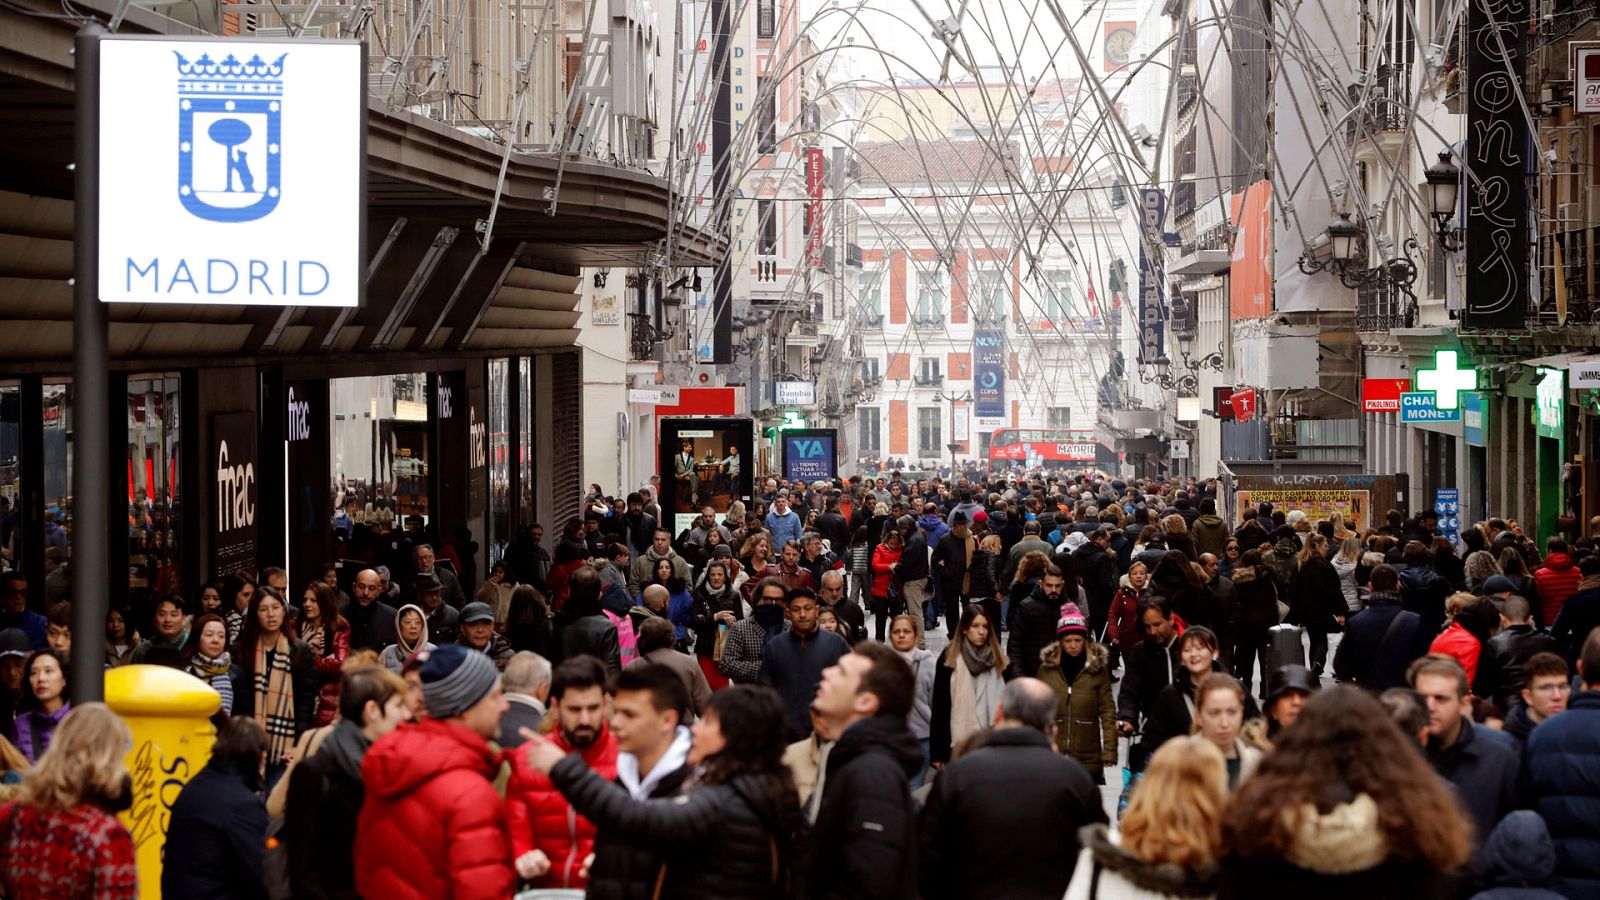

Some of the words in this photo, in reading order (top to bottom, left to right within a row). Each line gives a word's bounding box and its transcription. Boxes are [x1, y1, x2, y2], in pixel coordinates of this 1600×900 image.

[734, 47, 744, 169] Danubo
[126, 256, 330, 296] MADRID
[288, 386, 310, 442] fnac
[438, 374, 453, 419] fnac
[1366, 400, 1397, 408] PIKOLINOS
[1403, 396, 1435, 406] CHA
[1407, 409, 1454, 419] MONEY
[469, 405, 486, 470] fnac
[793, 440, 825, 458] YA
[217, 439, 255, 533] fnac
